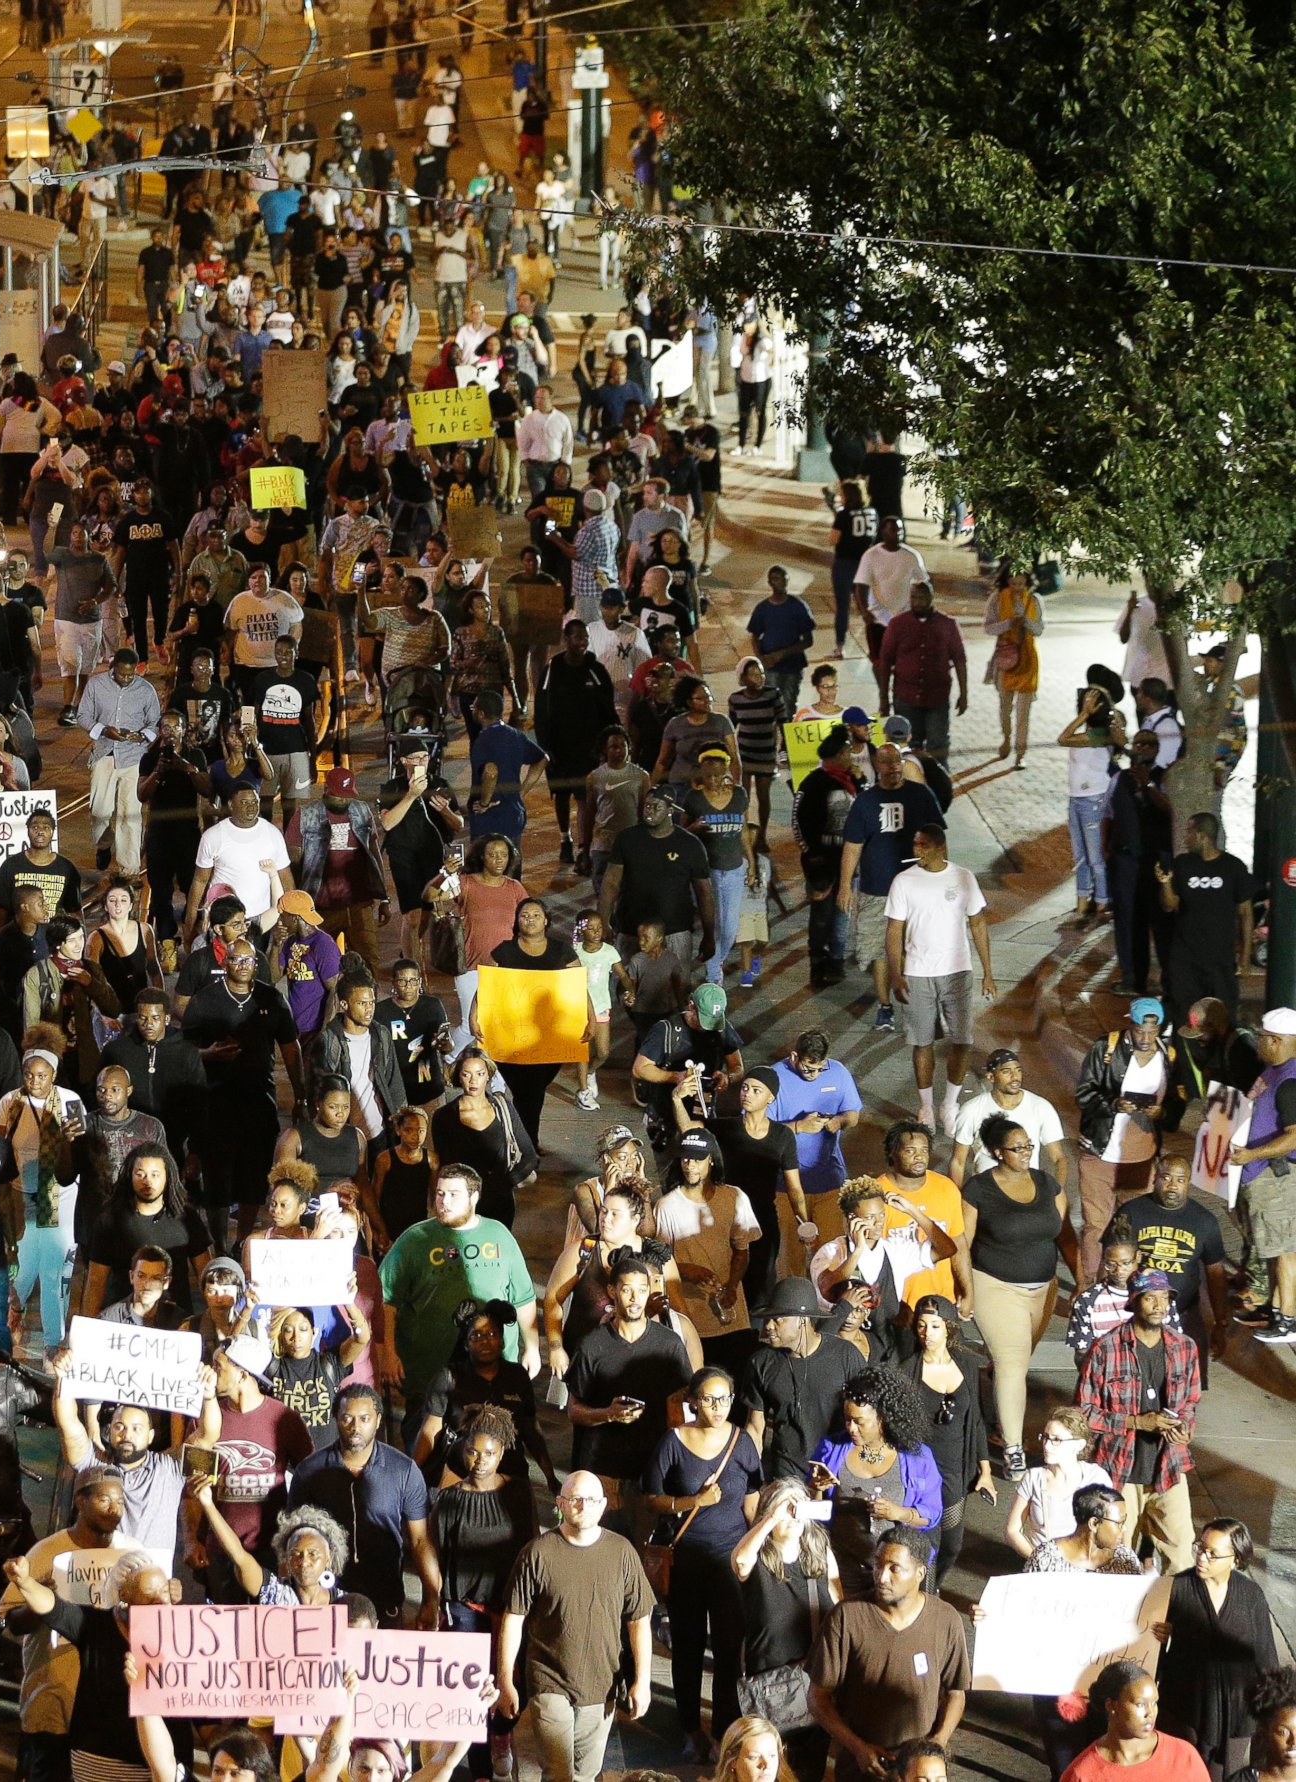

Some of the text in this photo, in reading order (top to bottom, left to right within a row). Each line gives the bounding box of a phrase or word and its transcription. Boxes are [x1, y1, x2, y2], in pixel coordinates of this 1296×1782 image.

[415, 386, 482, 405] RELEASE
[440, 407, 467, 416] THE
[428, 418, 483, 433] TAPES
[256, 474, 295, 489] #BLACK
[272, 489, 294, 498] LIVES
[852, 516, 877, 537] 05
[246, 612, 278, 623] BLACK
[247, 622, 279, 632] LIVES
[713, 1005, 720, 1015] P
[1138, 1226, 1195, 1249] ALPHA PHI ALPHA
[429, 1242, 500, 1266] COOGI
[65, 1363, 200, 1395] #BLACK LIVES
[118, 1389, 201, 1411] MATTER
[283, 1393, 330, 1412] IRLS
[142, 1606, 336, 1659] JUSTICE!
[355, 1639, 483, 1689] Justice
[144, 1658, 346, 1691] NOT JUSTIFICATION
[164, 1692, 315, 1709] #BLACKLIVESMATTER
[353, 1692, 443, 1729] Peace
